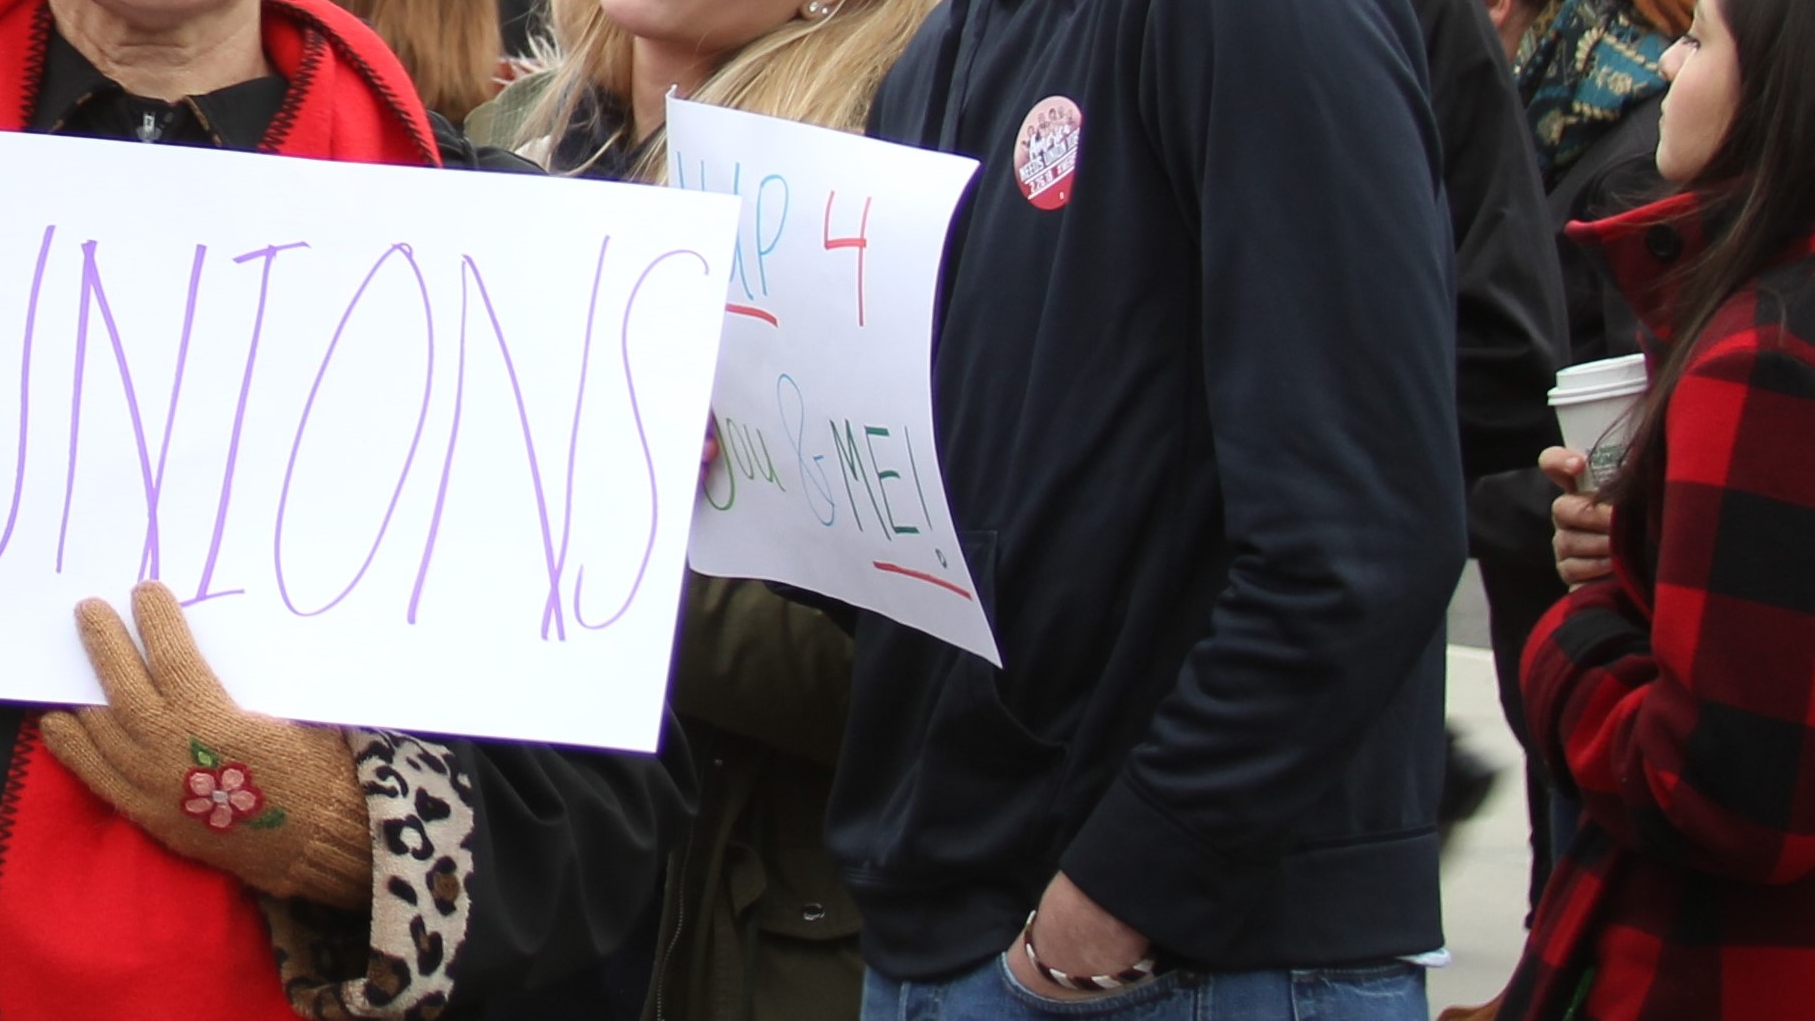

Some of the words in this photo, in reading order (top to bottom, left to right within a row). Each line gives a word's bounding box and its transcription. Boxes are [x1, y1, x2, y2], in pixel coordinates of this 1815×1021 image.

[823, 189, 873, 328] 4
[777, 373, 836, 527] &
[829, 417, 949, 569] ME!
